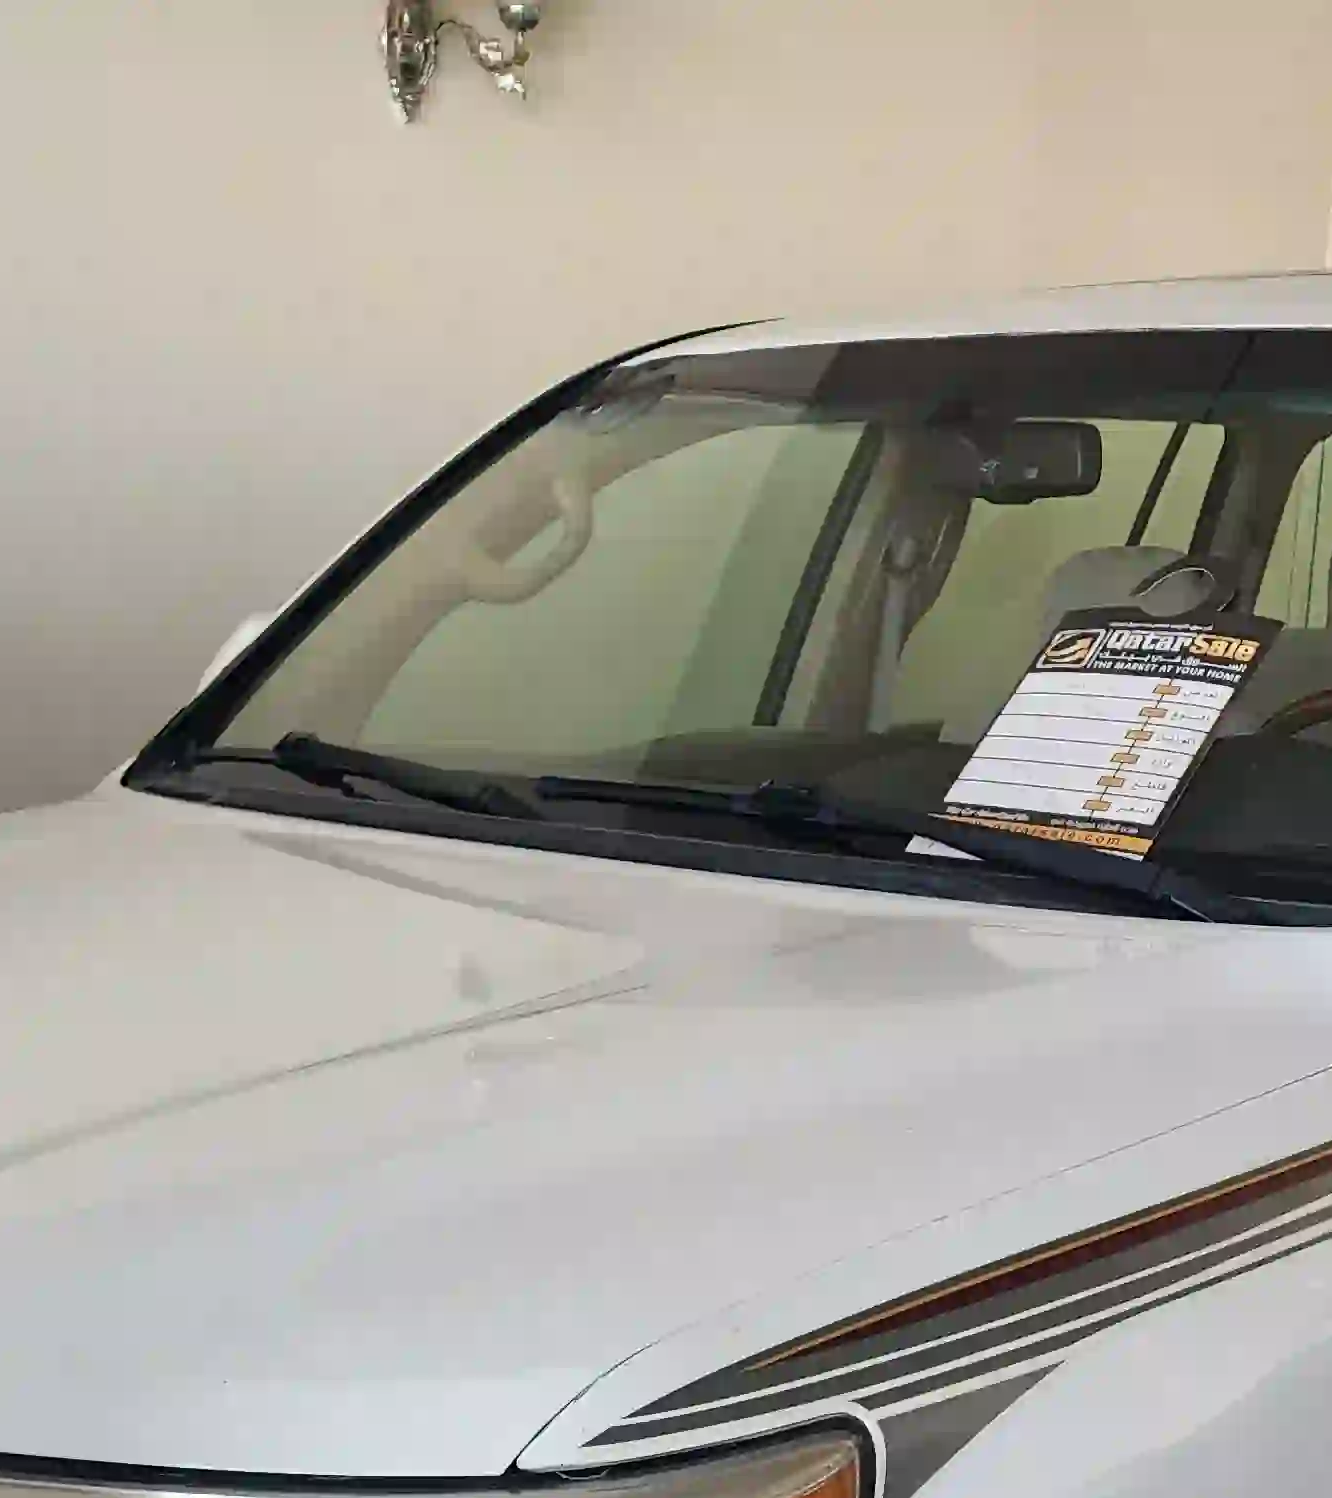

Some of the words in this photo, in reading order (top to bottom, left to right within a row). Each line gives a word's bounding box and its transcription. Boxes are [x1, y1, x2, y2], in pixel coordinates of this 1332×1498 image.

[1105, 628, 1260, 663] QatarSale
[1093, 660, 1112, 669] THE
[1114, 660, 1158, 673] MARKET
[1158, 664, 1174, 673] AT
[1175, 665, 1205, 677] YOUR
[1206, 669, 1243, 683] HOME
